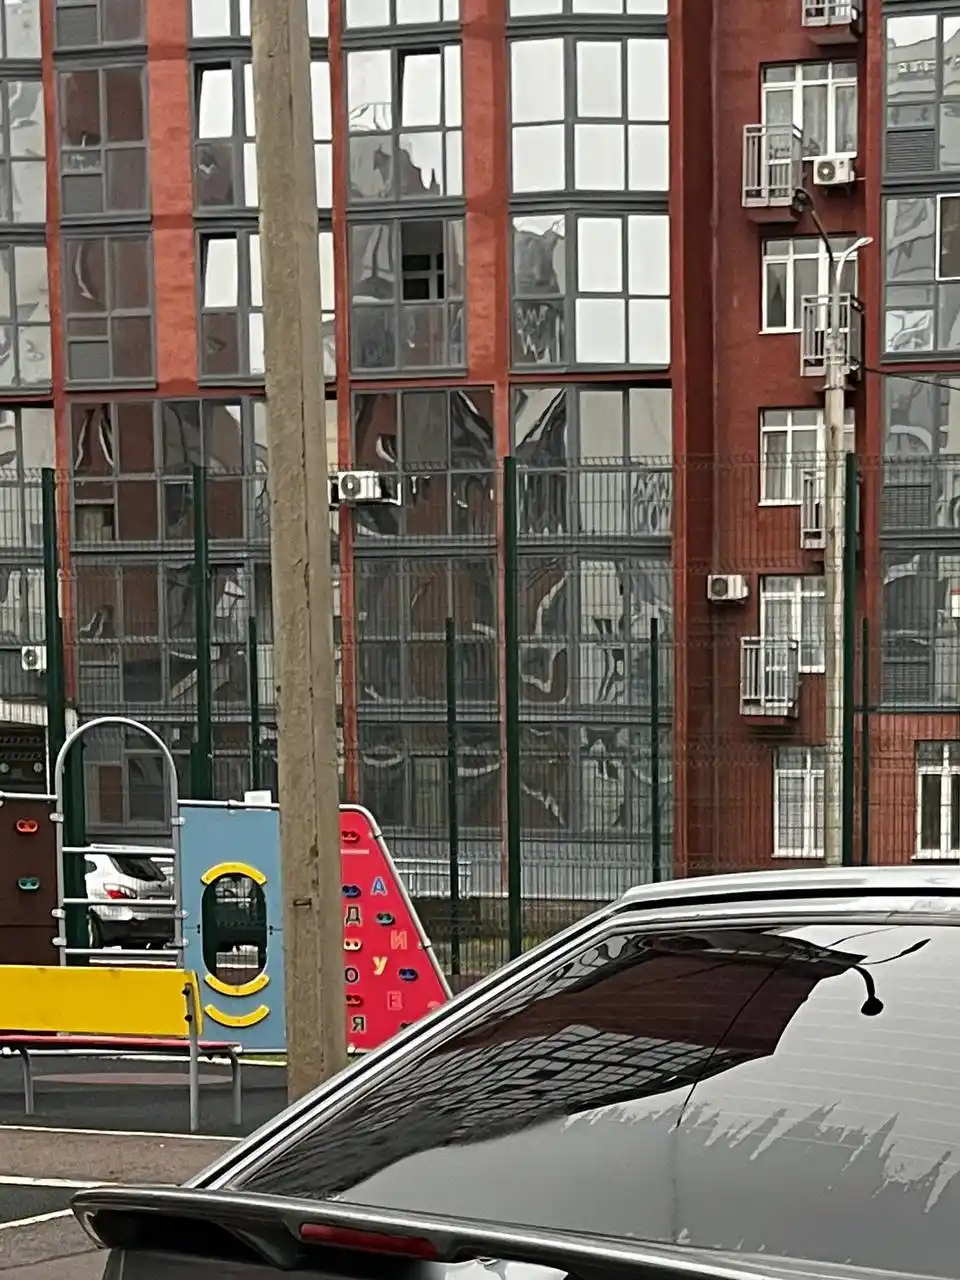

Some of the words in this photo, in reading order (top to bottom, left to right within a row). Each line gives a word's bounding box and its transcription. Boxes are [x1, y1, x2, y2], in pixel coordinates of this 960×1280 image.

[371, 876, 387, 896] А
[344, 905, 362, 927] Д
[344, 967, 359, 983] О
[372, 955, 388, 976] У
[351, 1014, 366, 1034] Я
